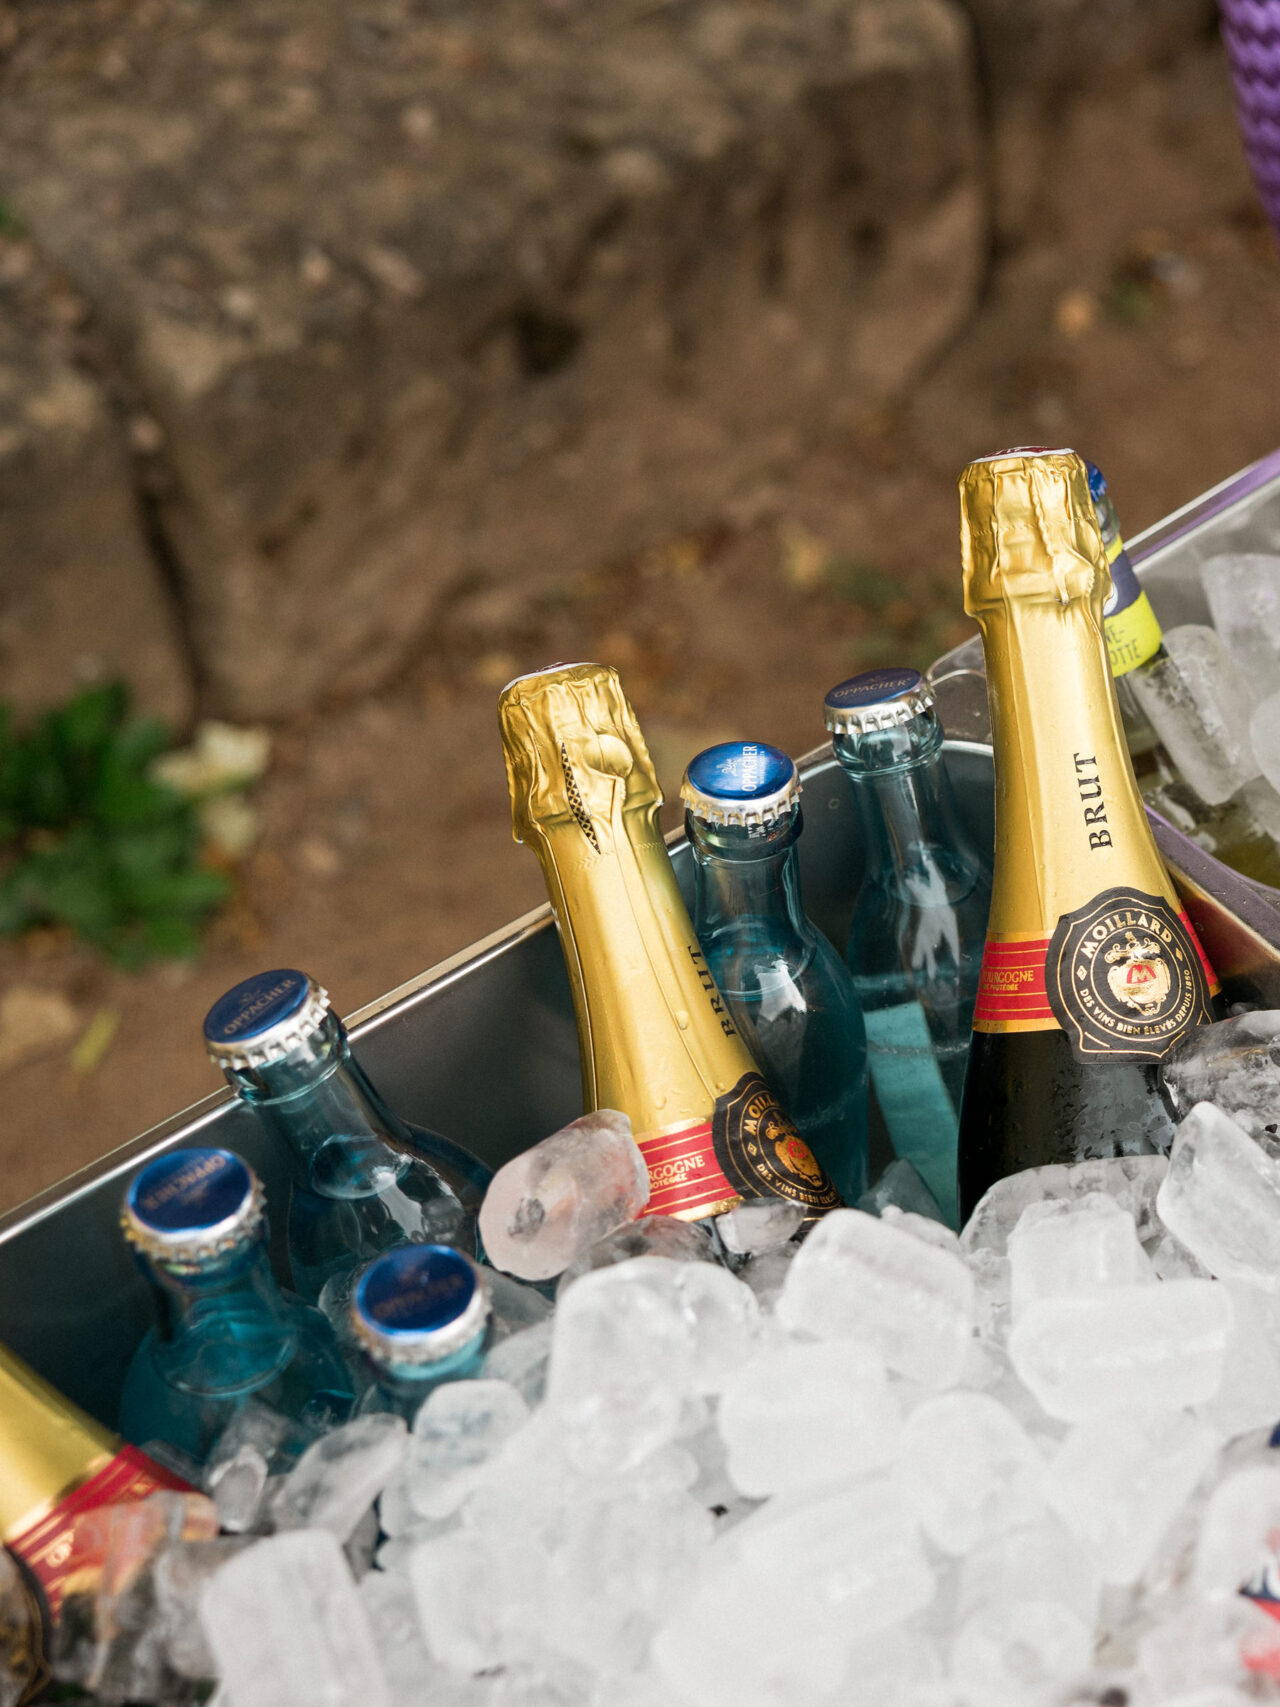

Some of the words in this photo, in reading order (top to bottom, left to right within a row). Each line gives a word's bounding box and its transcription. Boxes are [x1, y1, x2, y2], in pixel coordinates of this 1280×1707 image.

[834, 680, 908, 698] OPPACHER
[1073, 752, 1113, 851] BRUT
[1080, 911, 1173, 959] MOILLARD
[223, 979, 297, 1034] OPPACHER
[687, 945, 737, 1037] BRUT
[1080, 988, 1095, 1008] DES
[1093, 1008, 1115, 1027] VINS
[1116, 1022, 1141, 1035] BIEN
[1143, 1020, 1177, 1036] ÉLEVÉS
[1174, 993, 1193, 1022] DEPUIS
[744, 1094, 779, 1135] MOILL
[648, 1155, 706, 1181] RGOGNE
[756, 1163, 773, 1181] DES
[775, 1181, 797, 1197] VINS
